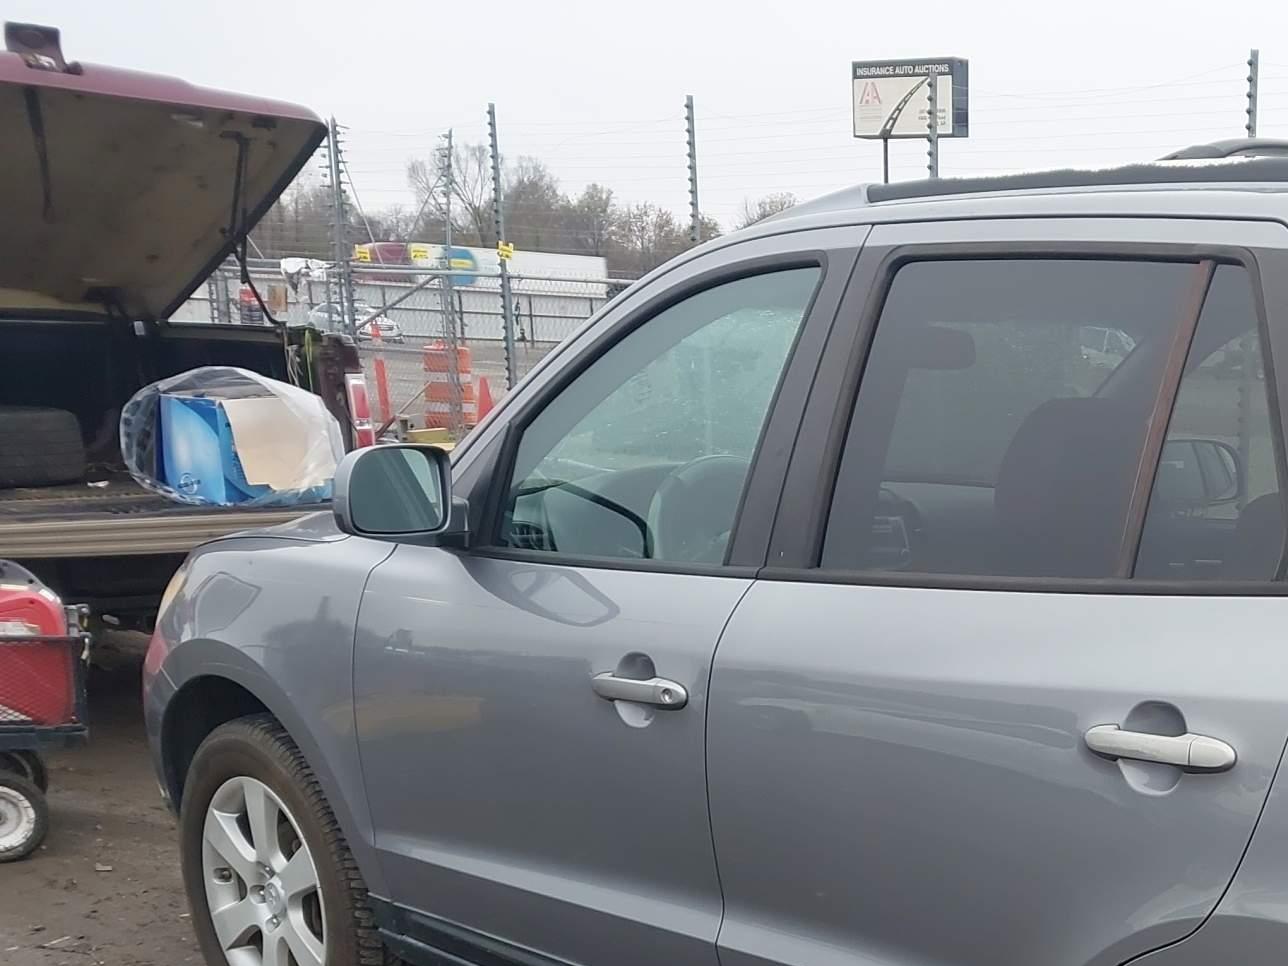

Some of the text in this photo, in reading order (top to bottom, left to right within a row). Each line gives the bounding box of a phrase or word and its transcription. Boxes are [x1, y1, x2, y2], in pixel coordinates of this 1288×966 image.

[856, 63, 949, 76] INSURANCE AUTO AUCTIONS
